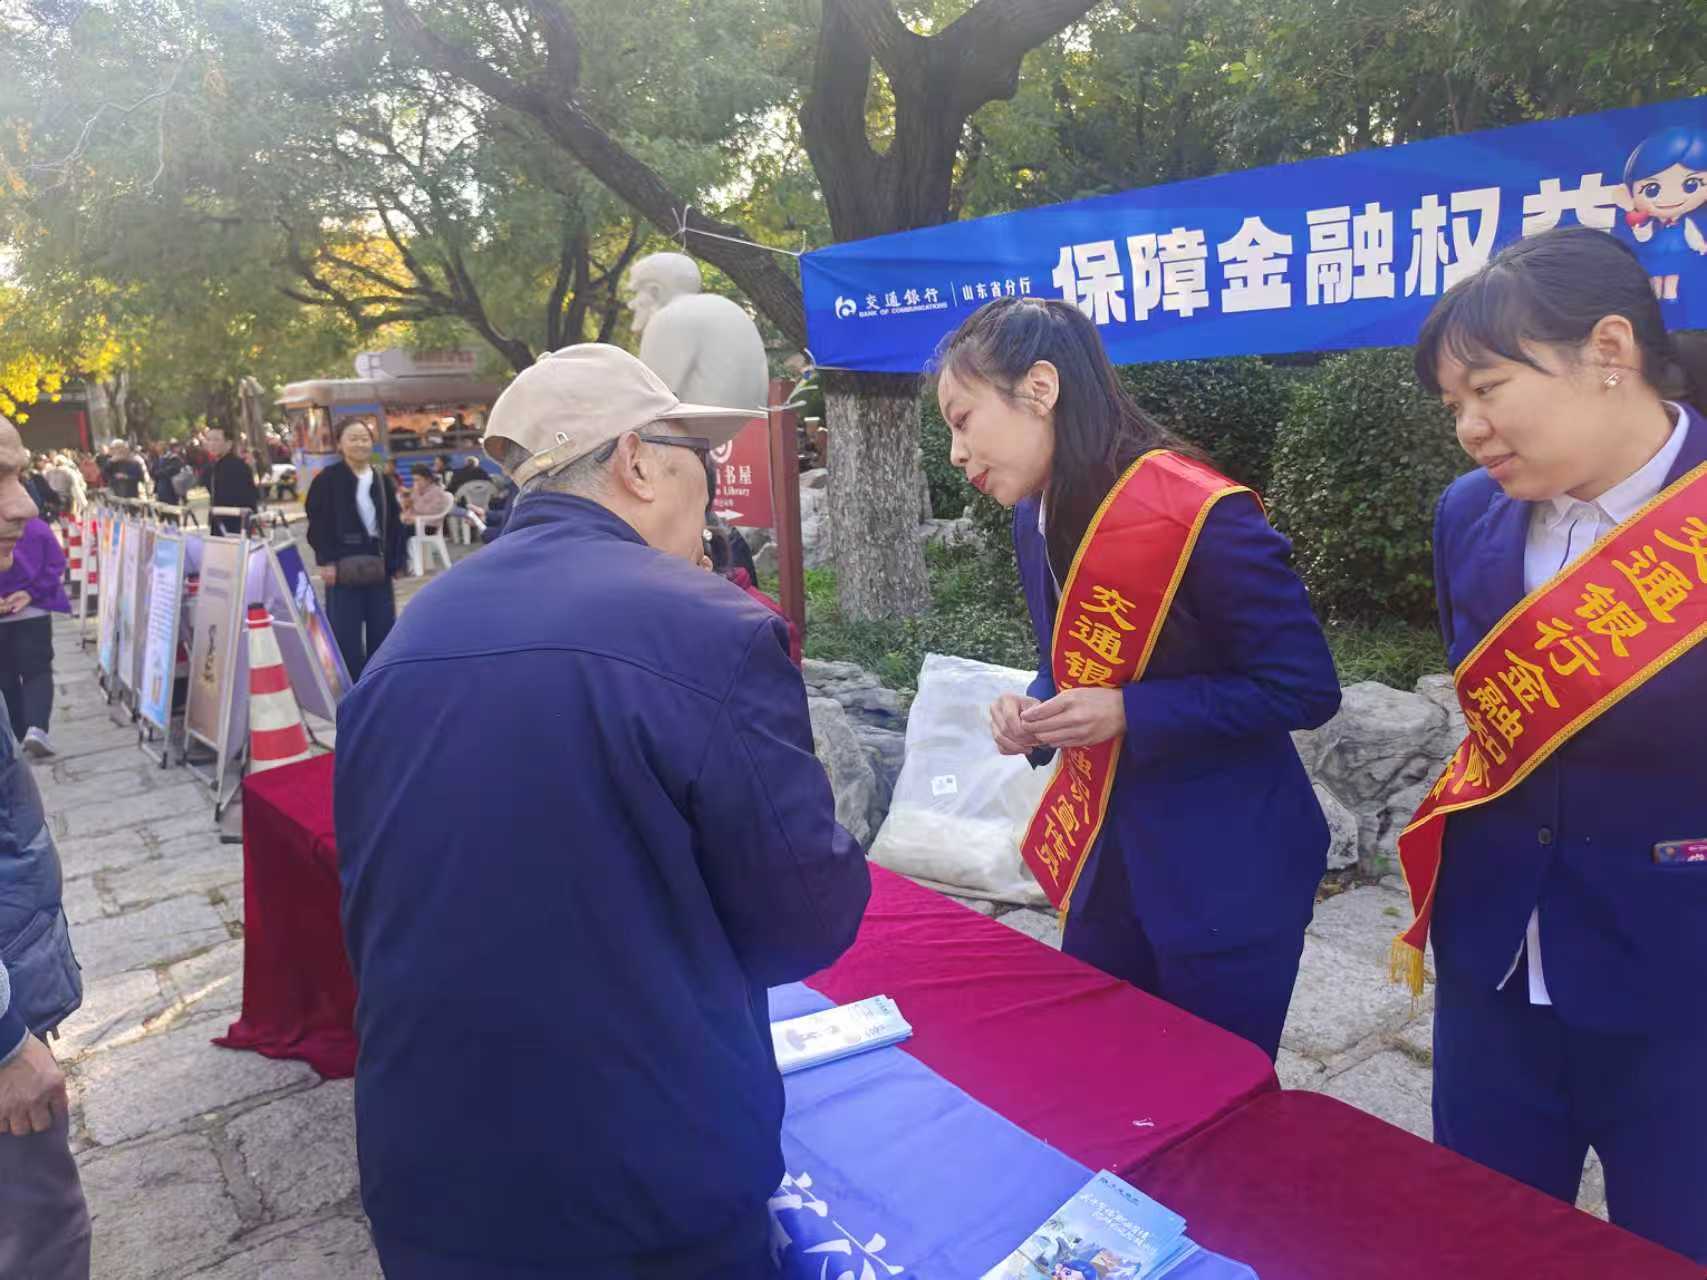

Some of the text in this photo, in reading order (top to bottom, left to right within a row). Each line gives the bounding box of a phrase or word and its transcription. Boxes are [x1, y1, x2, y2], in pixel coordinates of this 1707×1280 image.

[962, 276, 1031, 300] 山东省分行
[859, 310, 878, 318] BANK
[716, 464, 752, 485] 书屋
[723, 485, 750, 496] Library
